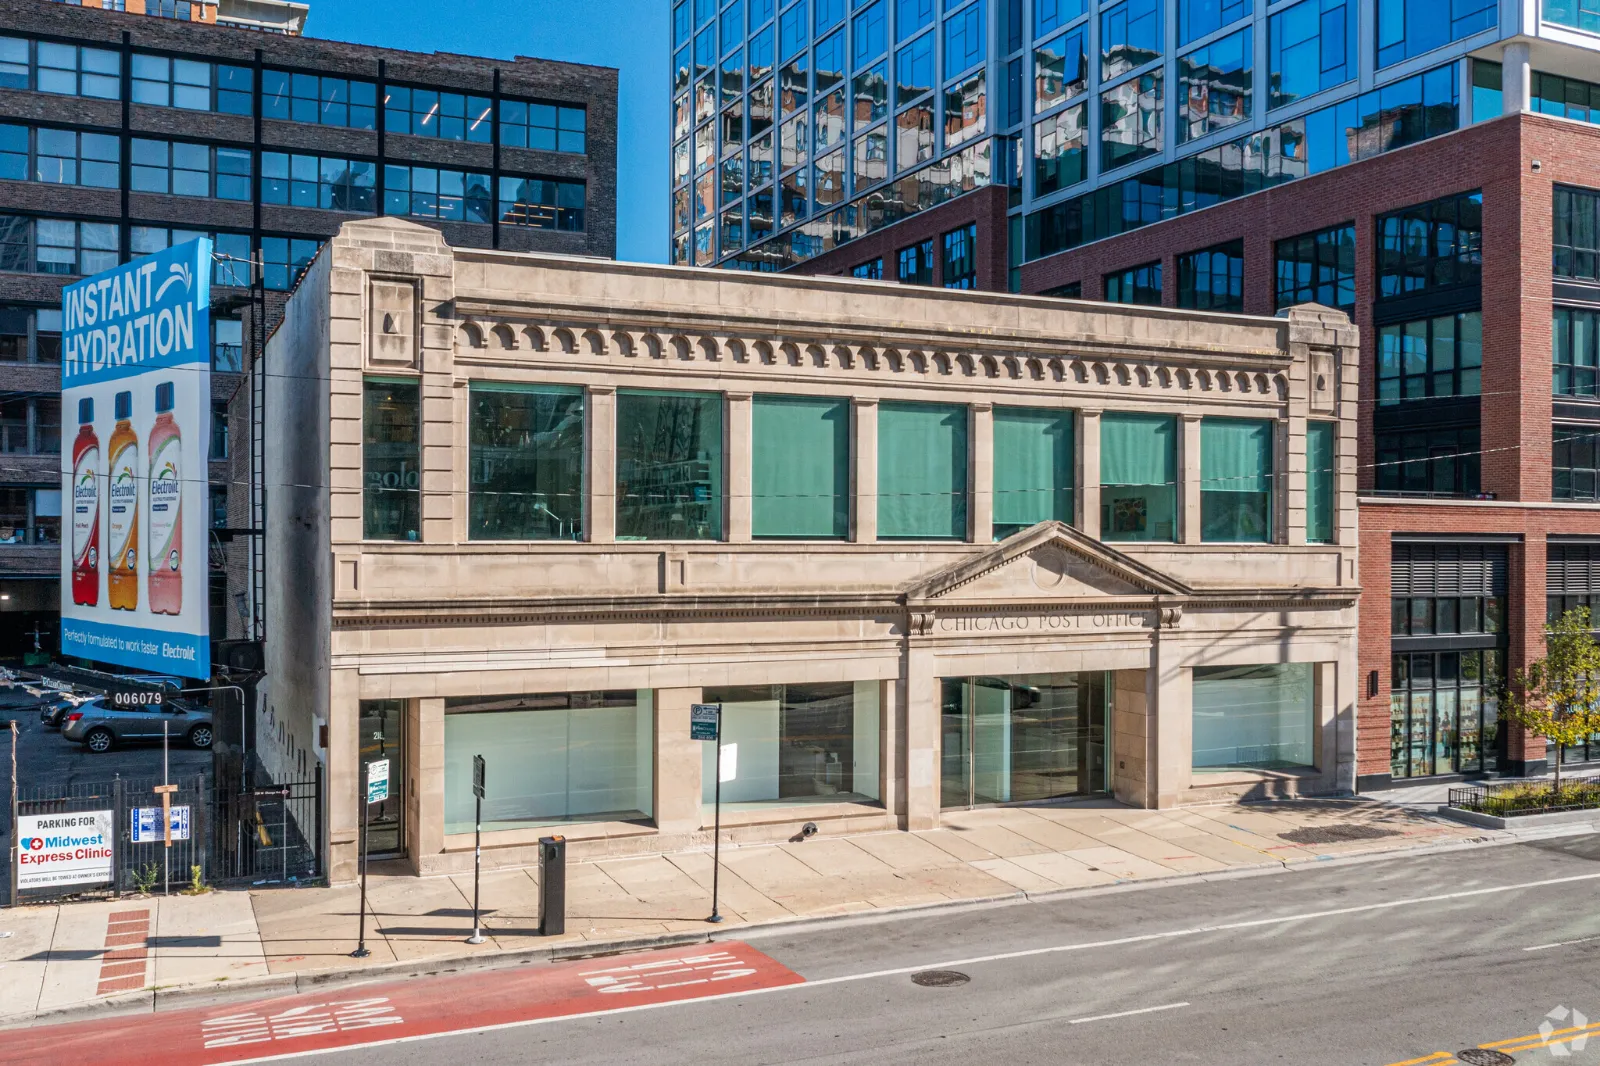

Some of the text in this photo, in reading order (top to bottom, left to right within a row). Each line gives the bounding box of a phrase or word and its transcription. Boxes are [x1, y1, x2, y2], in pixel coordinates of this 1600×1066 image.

[65, 261, 157, 331] INSTANT
[65, 301, 193, 377] HYDRATION
[76, 485, 96, 498] Electrolit
[112, 483, 136, 497] Electrolit
[152, 480, 179, 494] Electrolit
[940, 611, 1150, 631] CHICAGO POST OFFICE
[64, 628, 196, 660] Perfectly formulated to work faster Electrolit
[115, 692, 162, 705] 006079
[37, 816, 95, 829] PARKING FOR
[45, 834, 103, 848] Midwest
[20, 847, 112, 865] Express Clinic
[578, 951, 757, 993] CTA
[201, 997, 404, 1049] BUS
